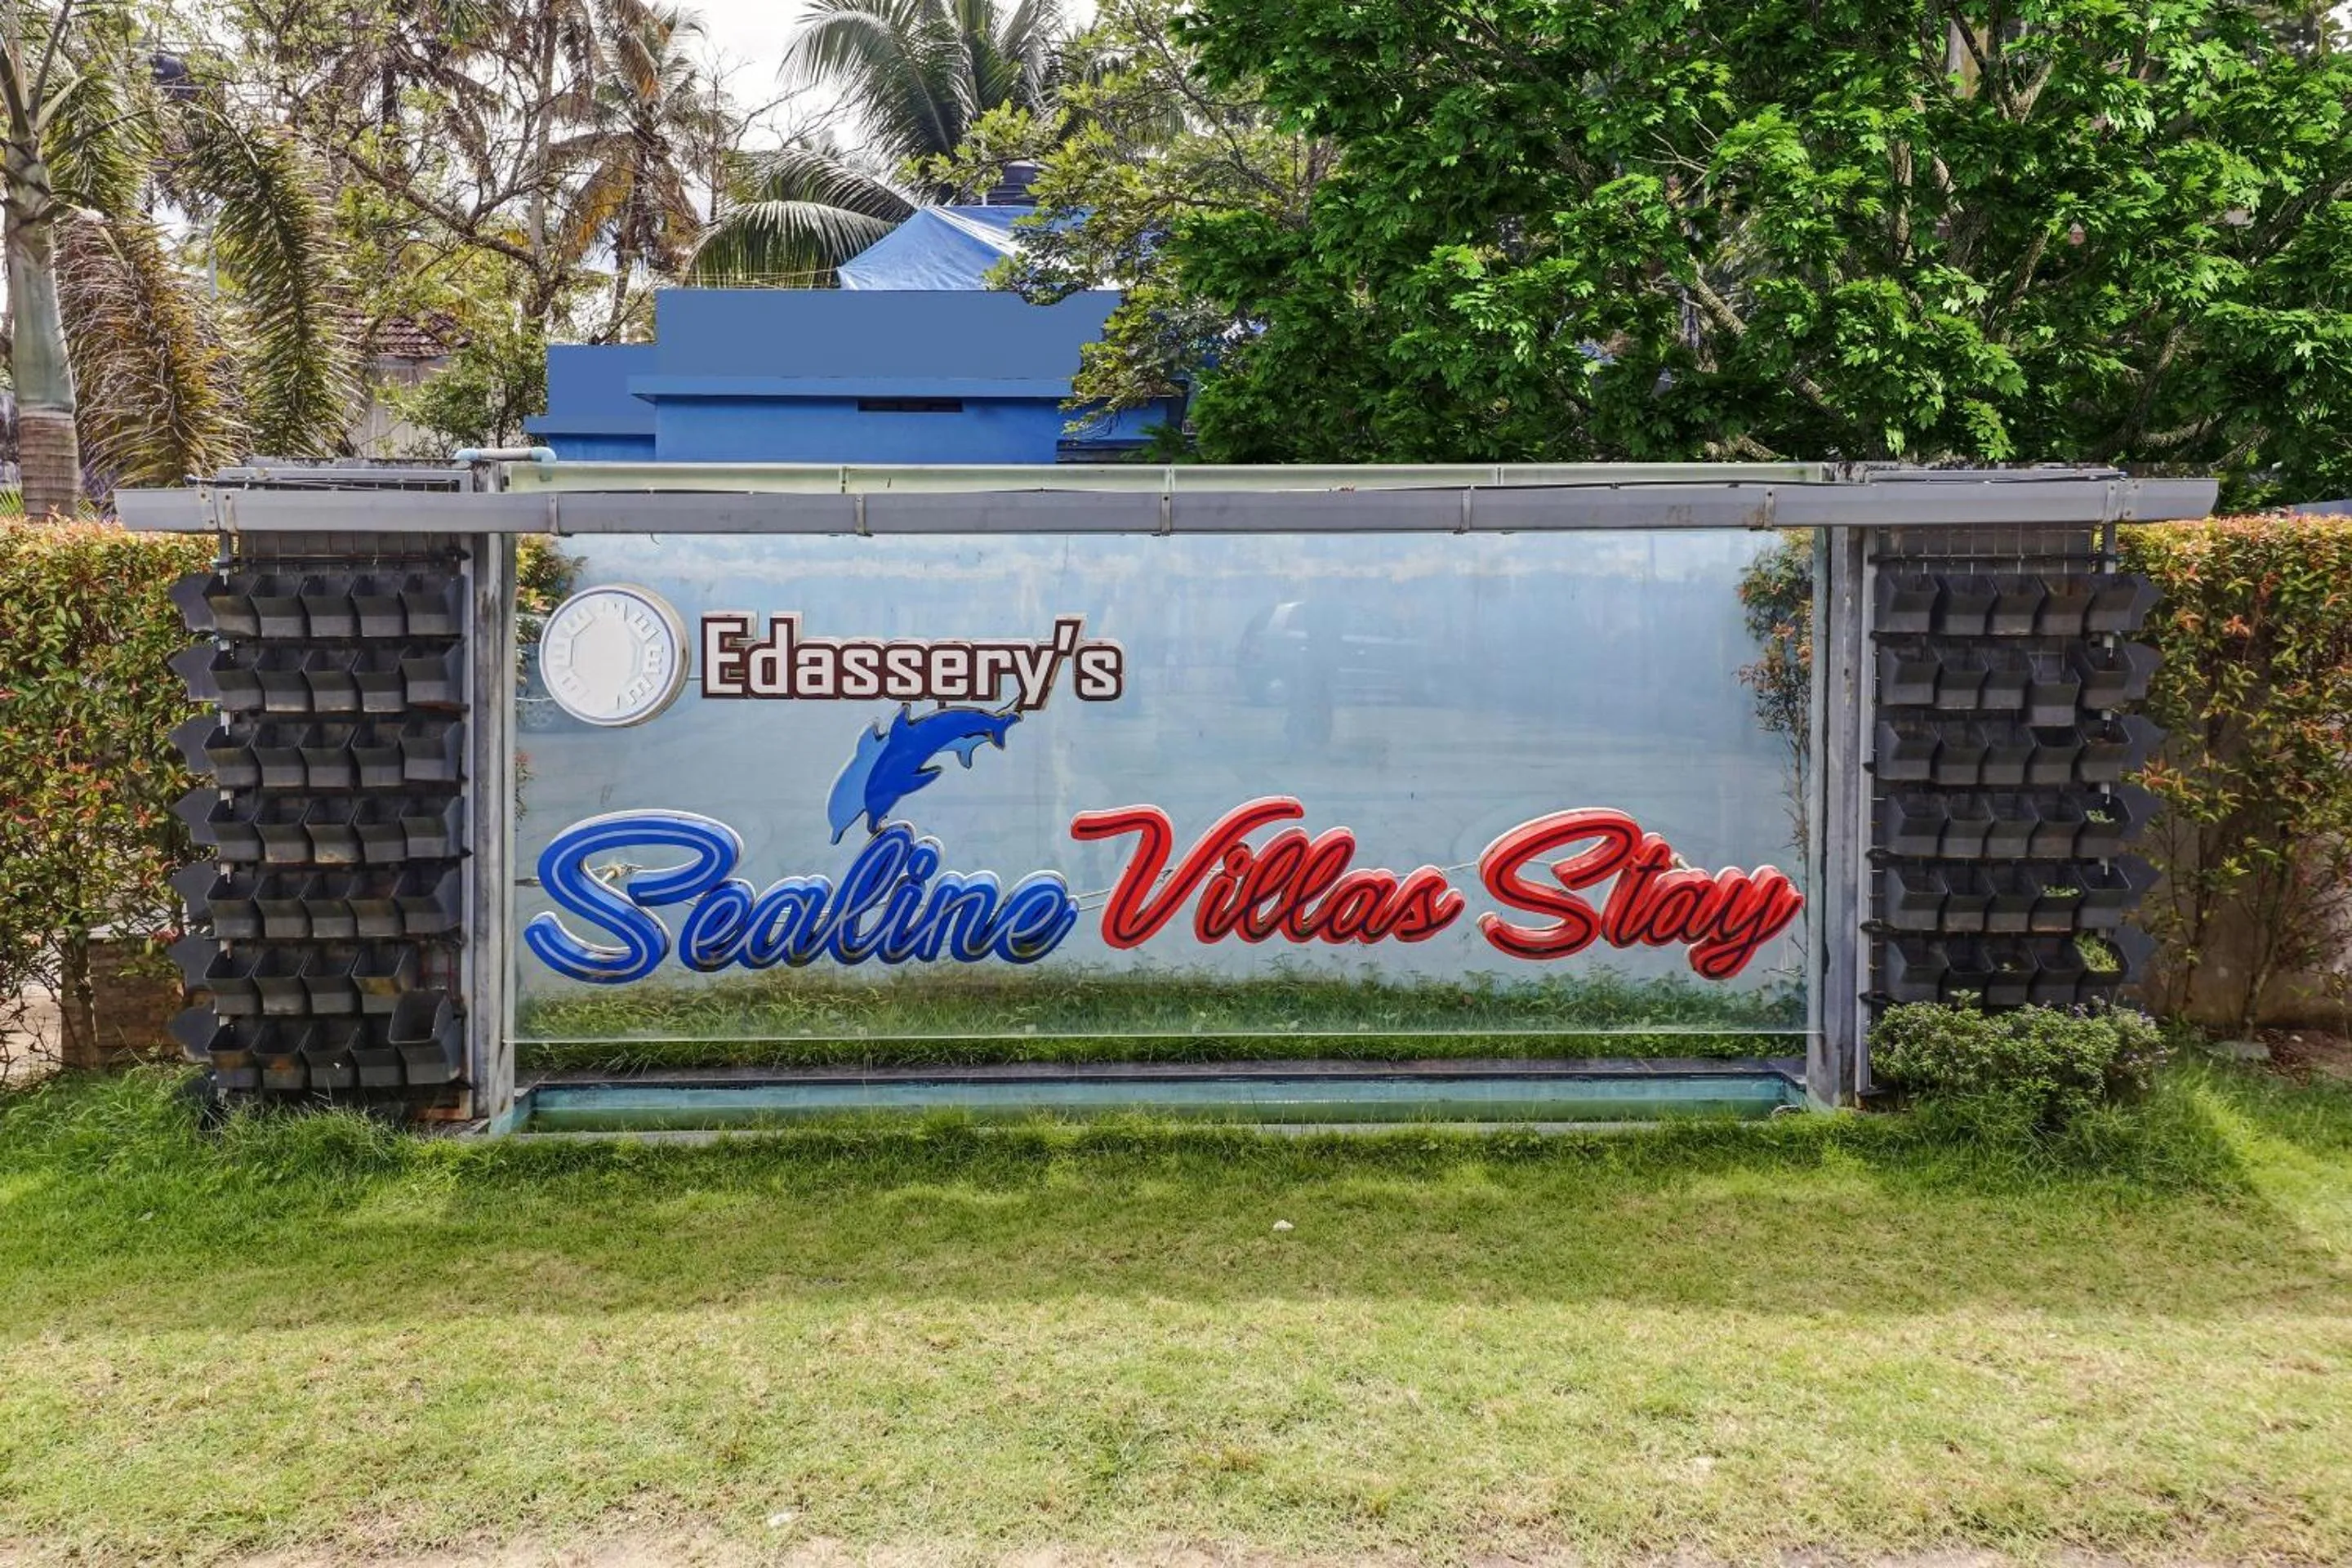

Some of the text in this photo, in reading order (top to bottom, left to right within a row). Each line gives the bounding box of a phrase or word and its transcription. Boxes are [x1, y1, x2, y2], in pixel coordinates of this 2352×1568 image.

[702, 612, 1124, 710] Edassery's
[525, 796, 1802, 982] Sealine Villas Stay
